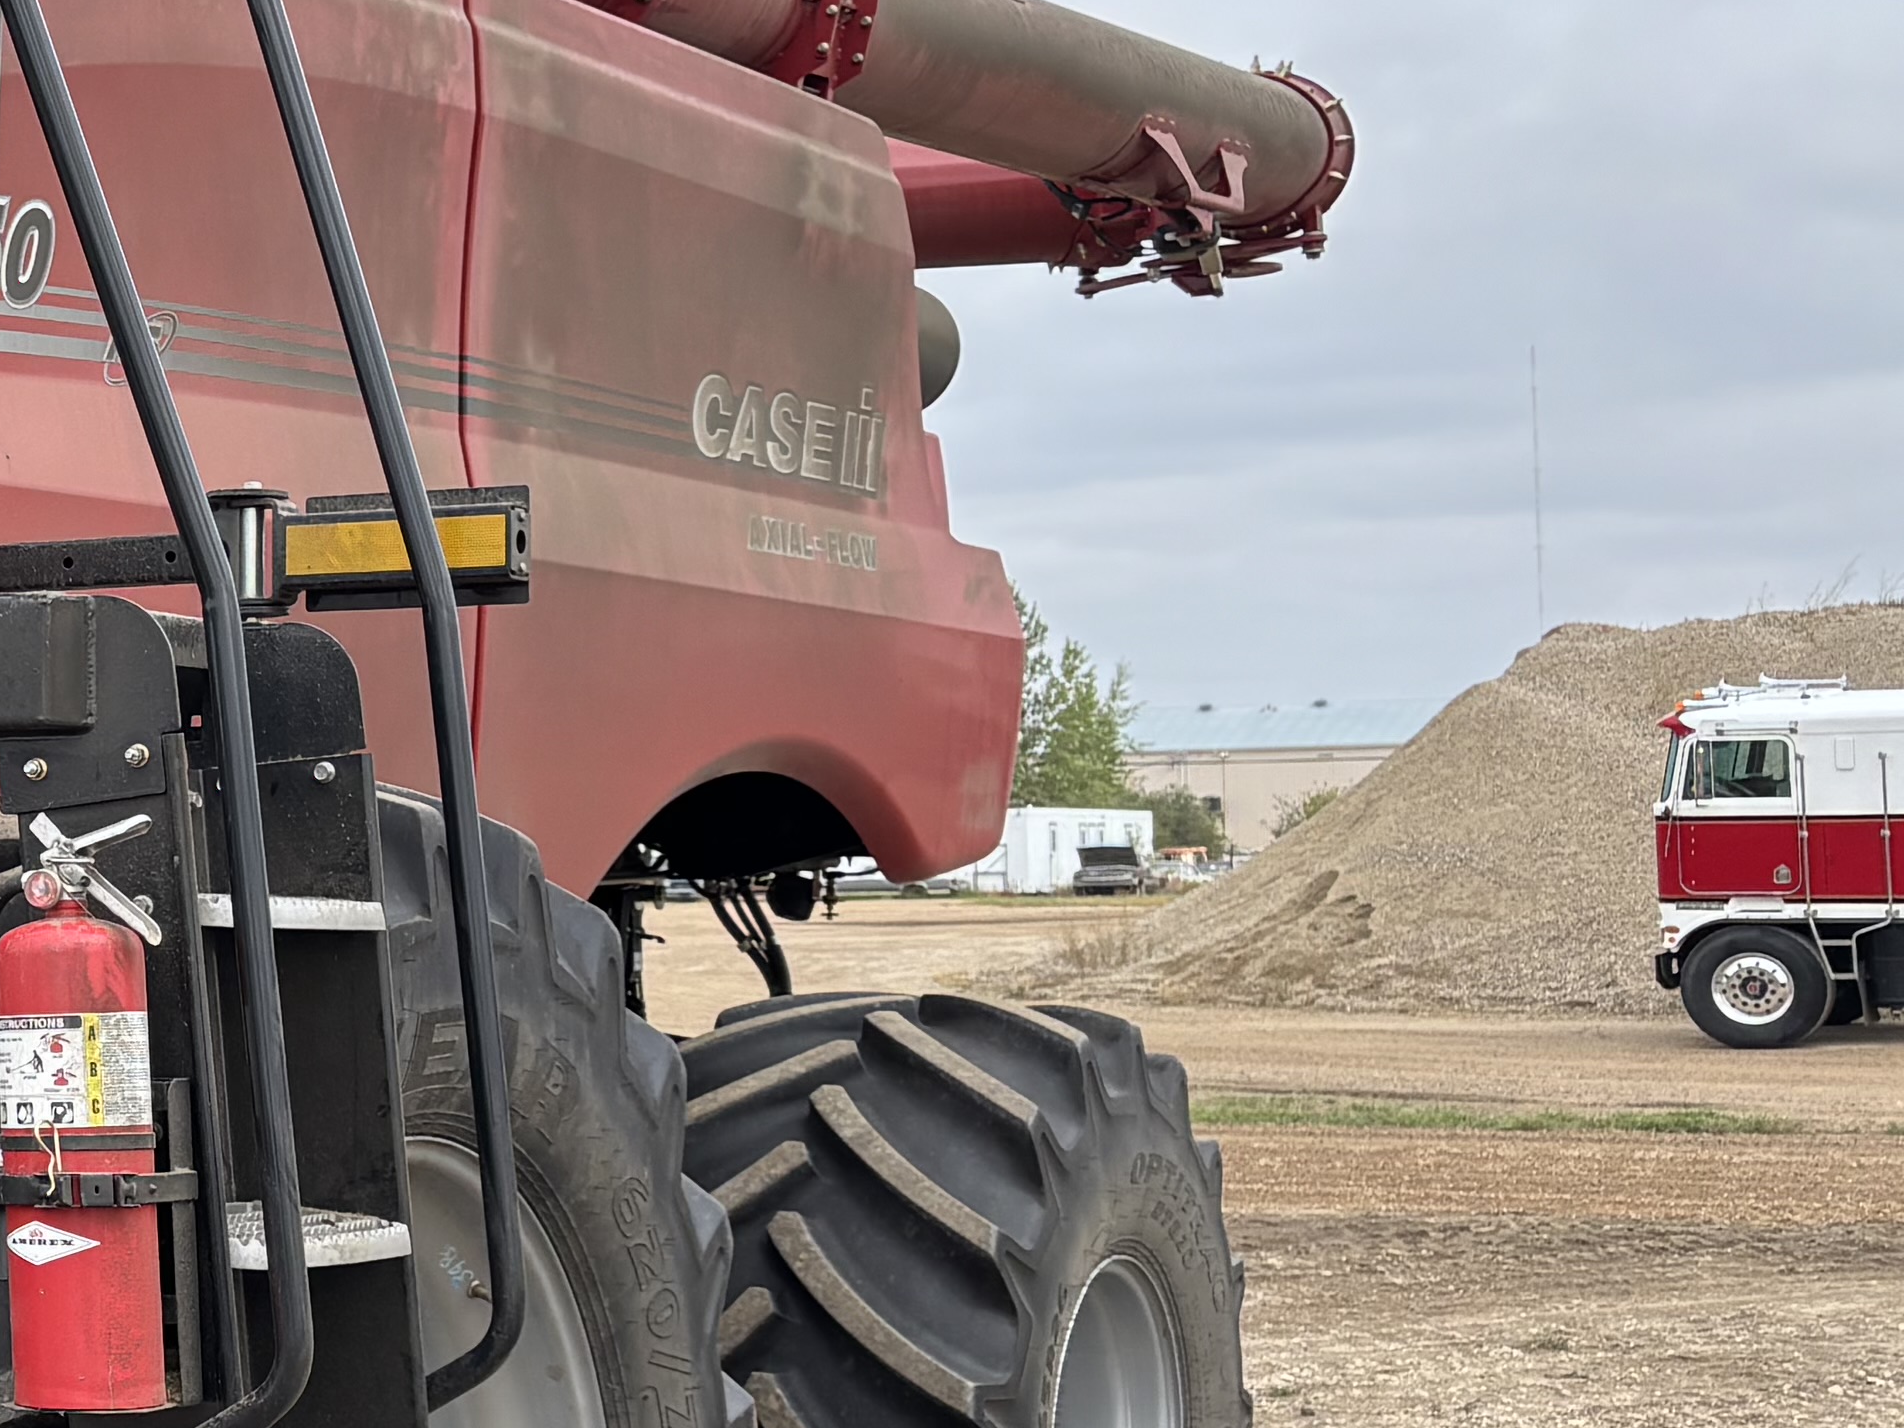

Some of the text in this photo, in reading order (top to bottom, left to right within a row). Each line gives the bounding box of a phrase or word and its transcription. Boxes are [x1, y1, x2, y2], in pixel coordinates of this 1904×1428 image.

[692, 374, 836, 481] CASE
[747, 515, 878, 571] AXIAL-FLOW
[88, 1025, 96, 1041] A
[90, 1062, 98, 1078] B
[91, 1098, 100, 1115] C
